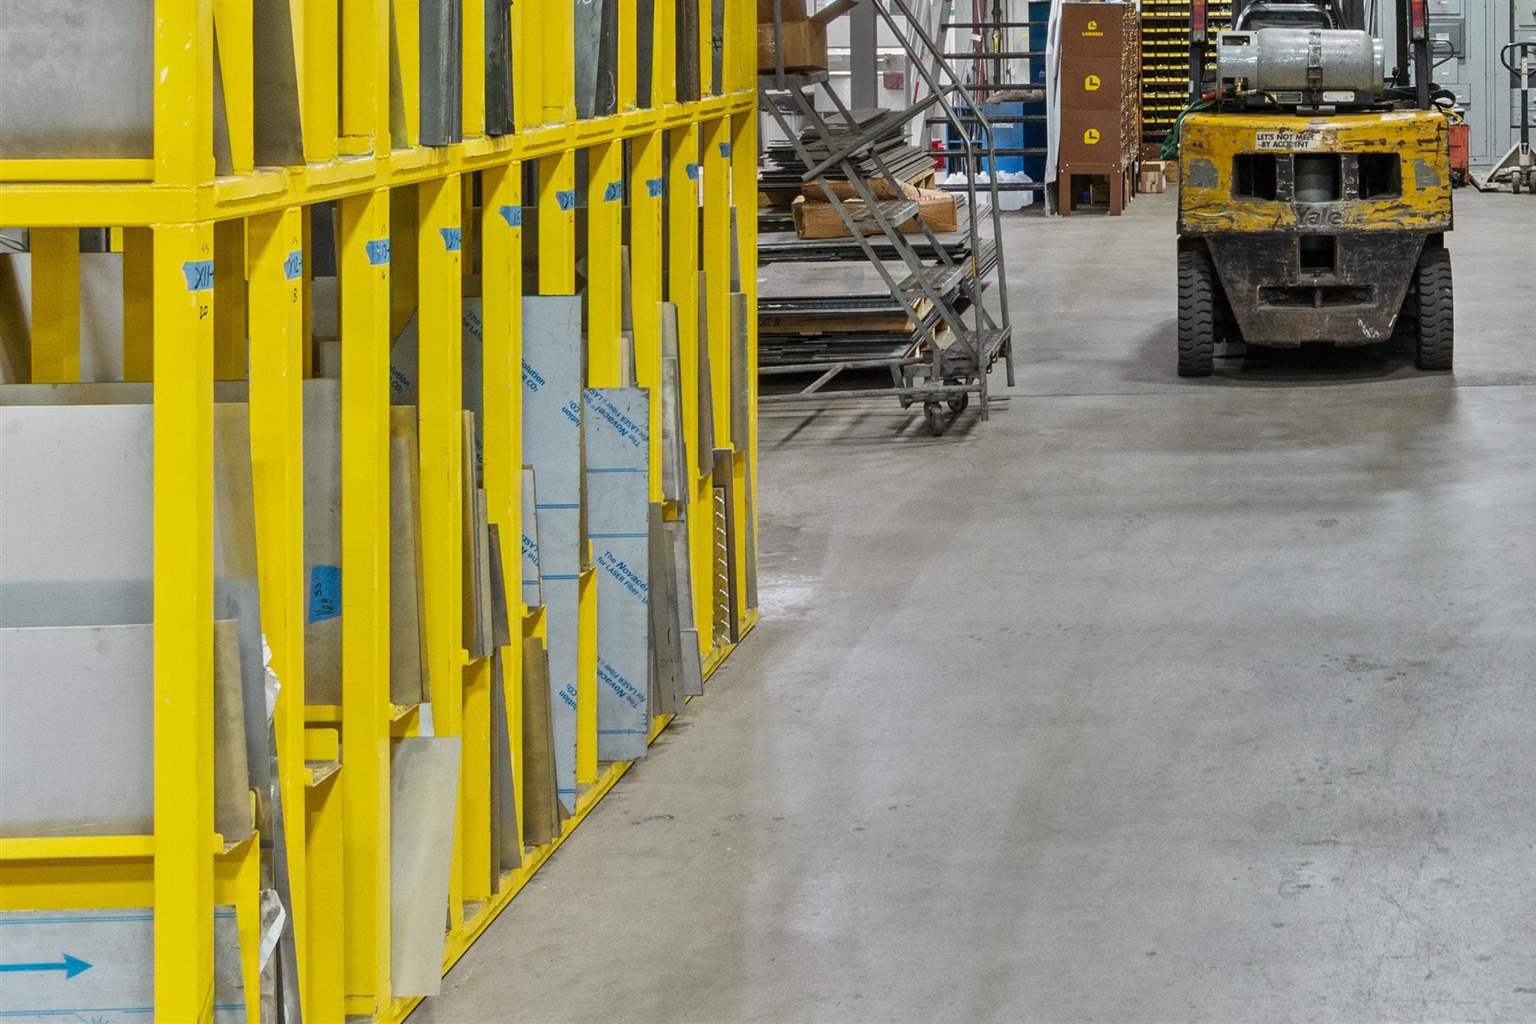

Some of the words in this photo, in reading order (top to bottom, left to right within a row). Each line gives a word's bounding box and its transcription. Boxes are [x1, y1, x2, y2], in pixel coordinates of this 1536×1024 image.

[1276, 133, 1293, 141] NOT
[1295, 206, 1342, 225] Yale
[628, 434, 641, 448] The
[604, 550, 617, 563] The
[597, 670, 626, 698] Novace
